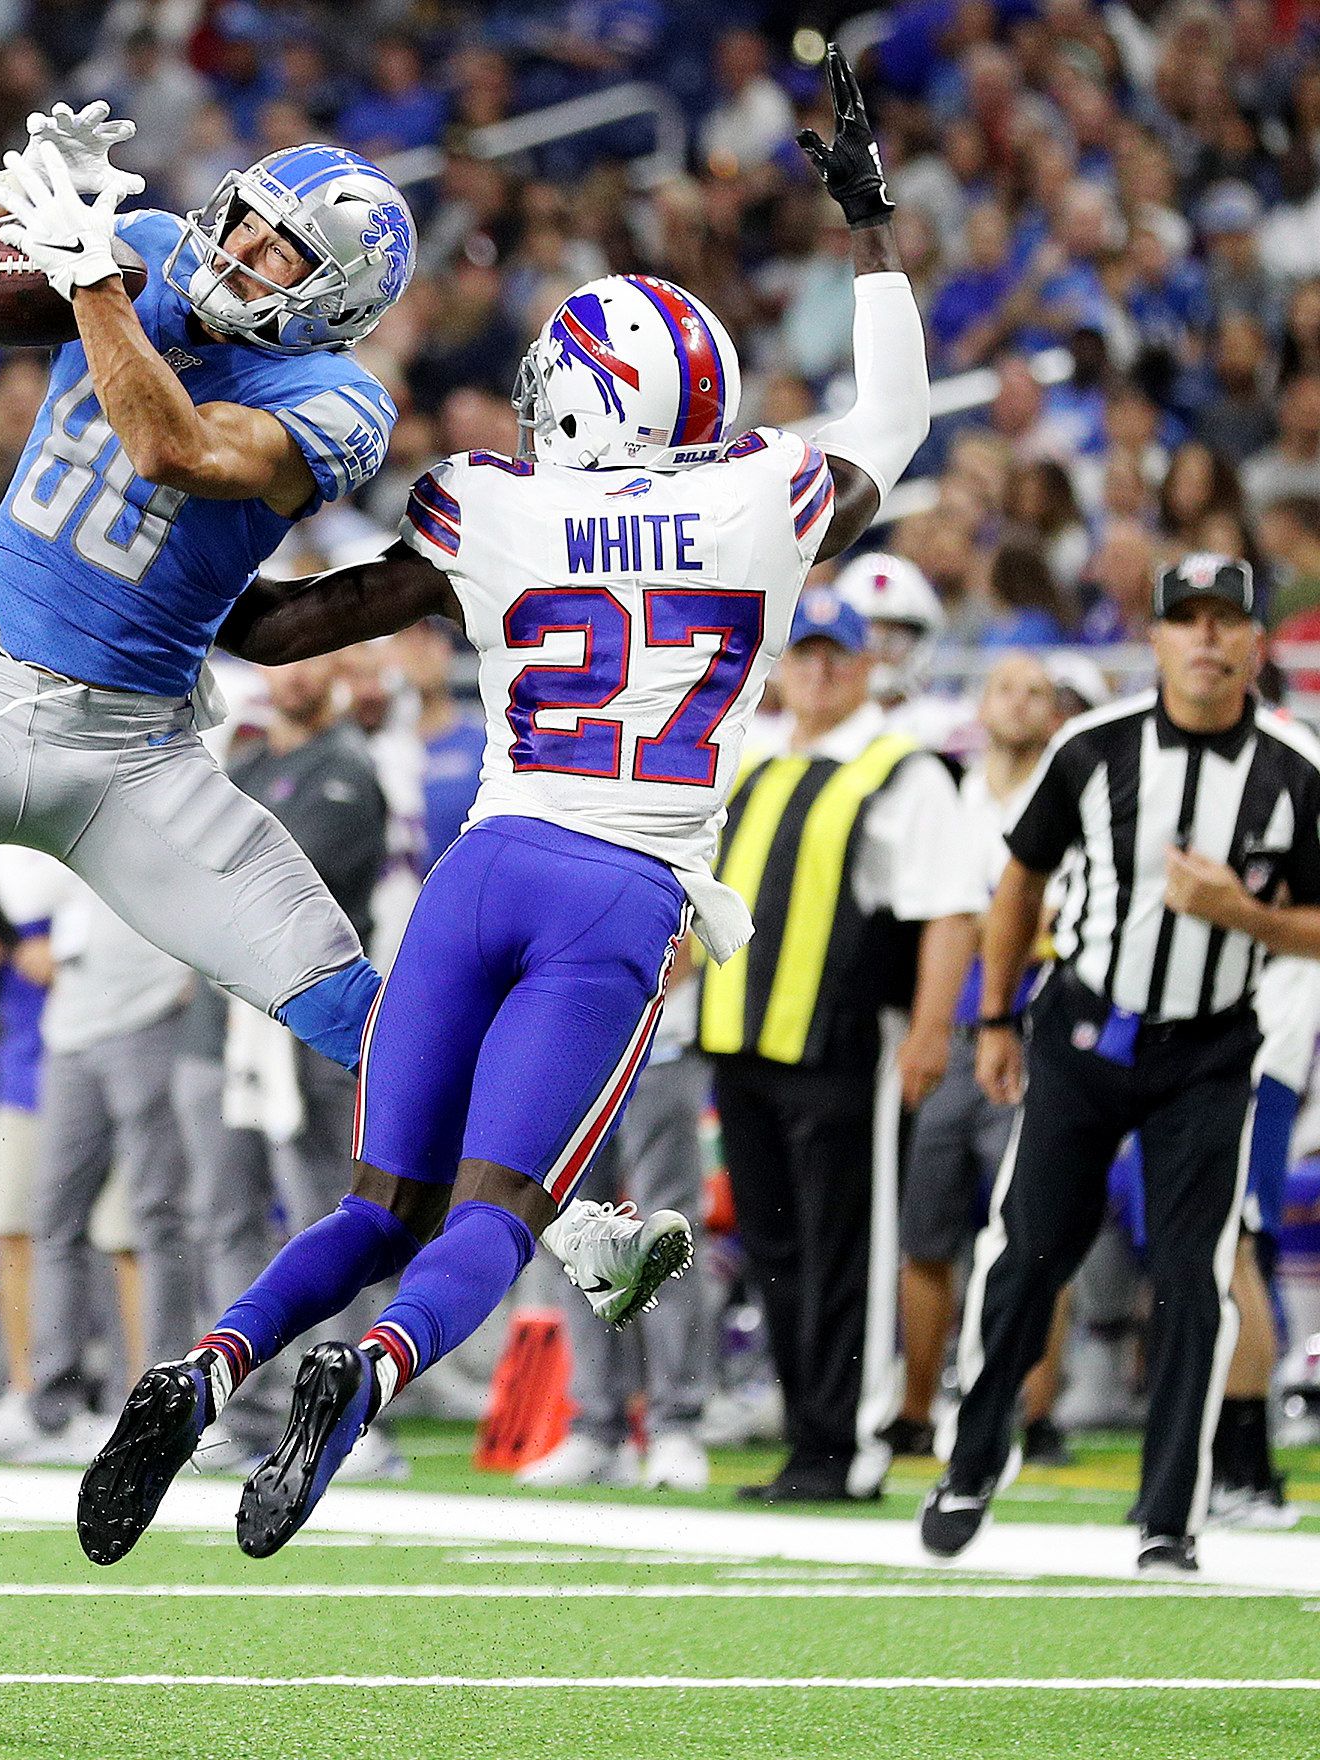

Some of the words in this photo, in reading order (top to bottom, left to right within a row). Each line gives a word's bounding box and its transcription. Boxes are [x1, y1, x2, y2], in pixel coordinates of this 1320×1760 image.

[672, 450, 719, 464] BILLS
[564, 512, 704, 574] WHITE
[503, 586, 766, 789] 27
